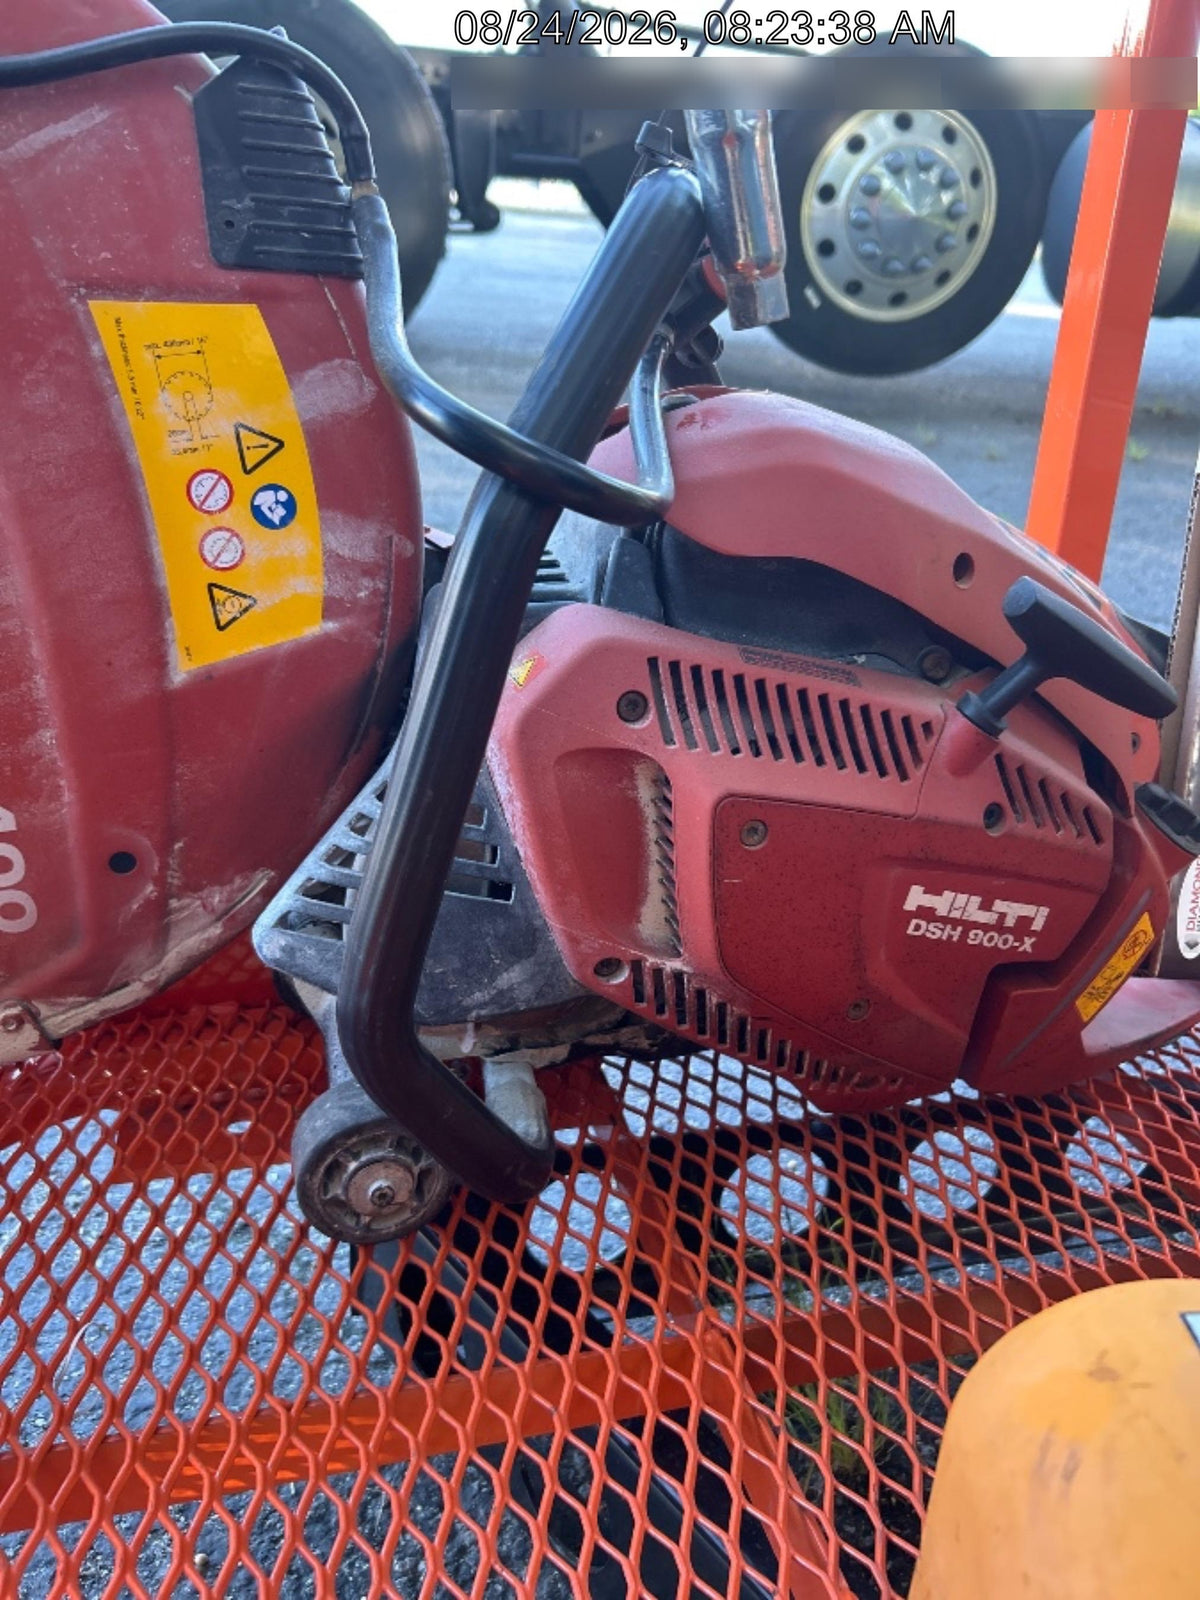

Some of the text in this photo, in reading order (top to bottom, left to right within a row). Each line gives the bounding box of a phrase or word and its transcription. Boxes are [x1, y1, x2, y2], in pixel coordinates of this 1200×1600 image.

[902, 884, 1051, 933] HILTI
[906, 918, 1037, 953] DSH 900-X
